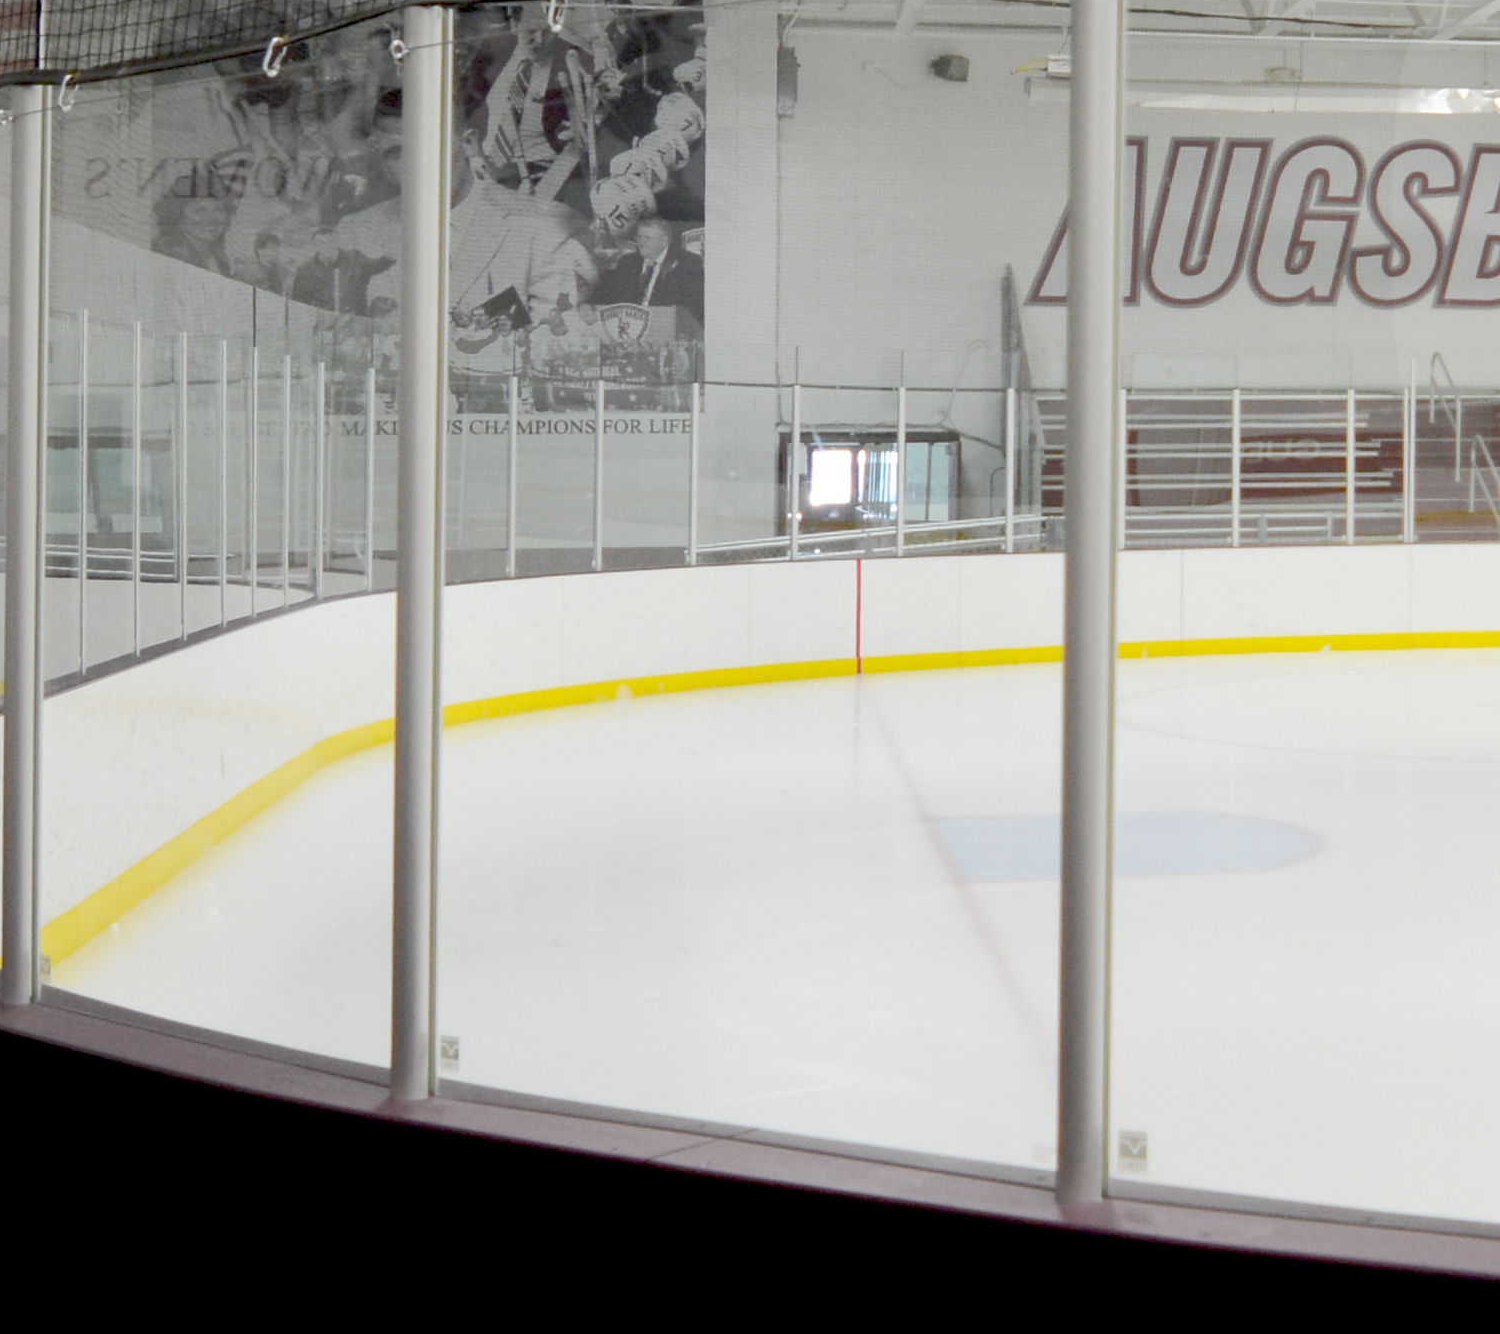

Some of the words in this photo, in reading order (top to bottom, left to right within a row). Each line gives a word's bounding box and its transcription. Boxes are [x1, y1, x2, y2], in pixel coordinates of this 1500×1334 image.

[341, 420, 398, 436] MKI
[469, 419, 597, 436] CHAMPIONS
[603, 419, 641, 434] FOR
[649, 419, 692, 434] LIFE
